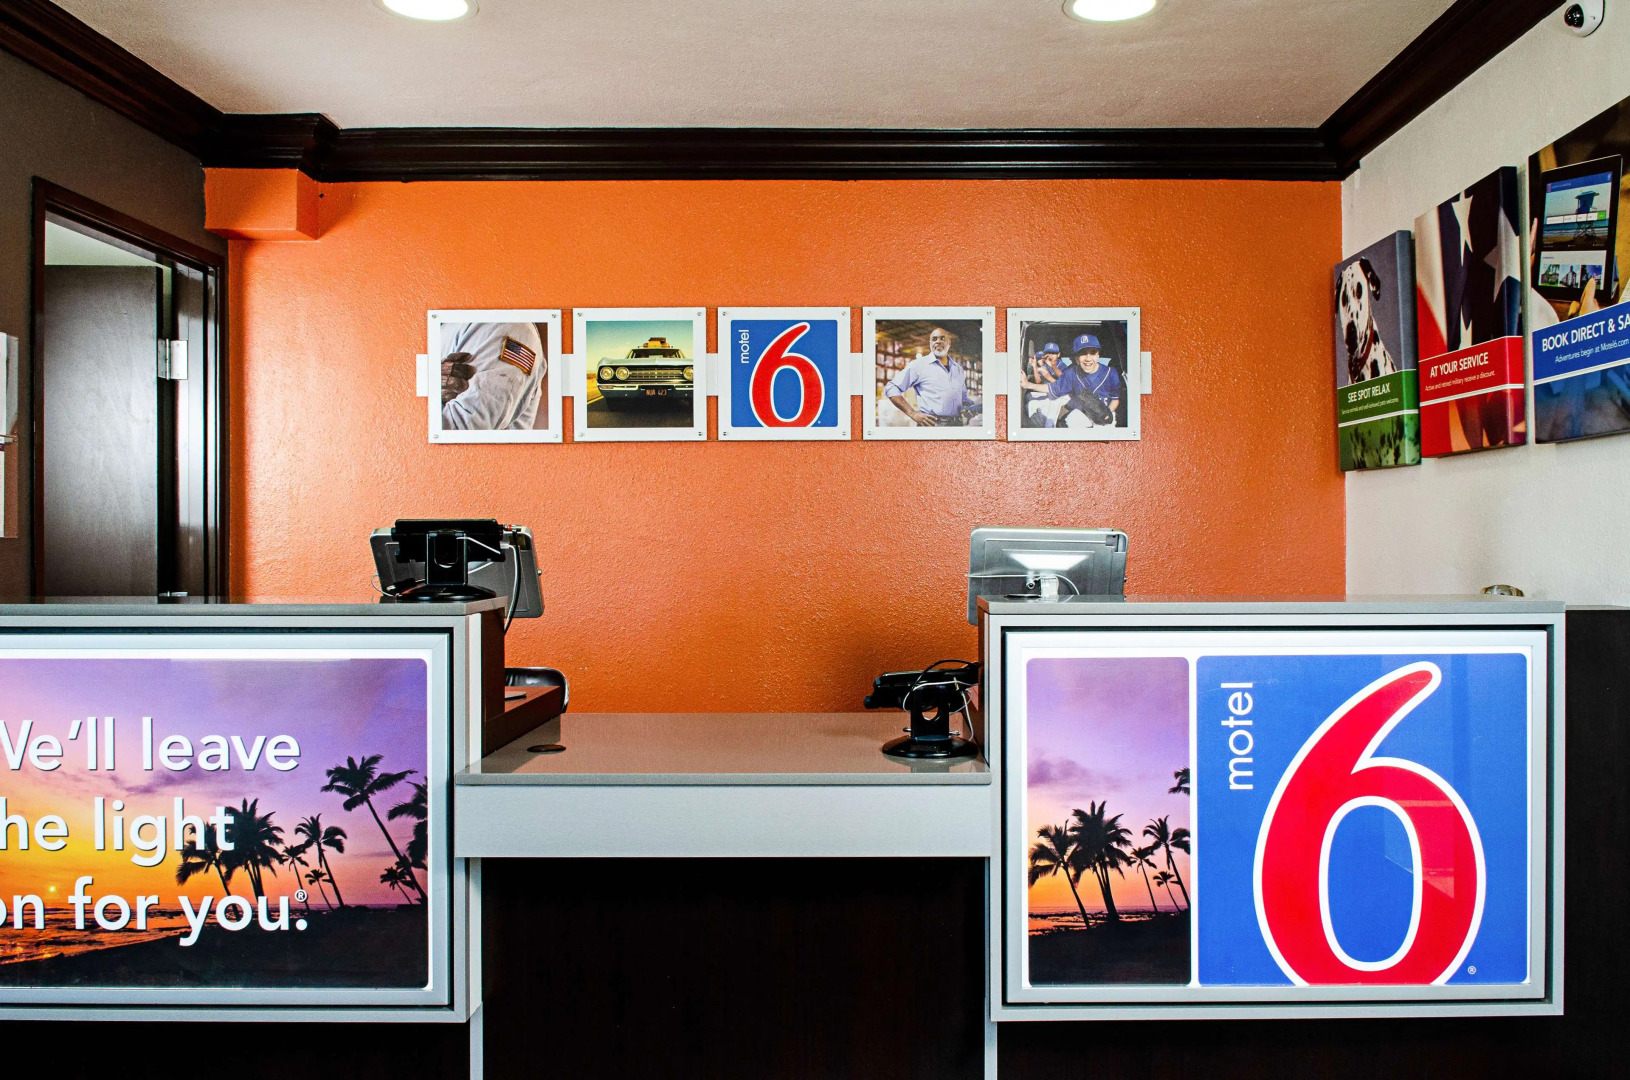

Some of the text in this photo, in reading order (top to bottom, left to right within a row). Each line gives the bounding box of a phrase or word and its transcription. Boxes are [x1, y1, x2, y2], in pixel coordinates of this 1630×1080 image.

[738, 329, 750, 364] motel
[1542, 331, 1569, 352] BOOK
[1571, 321, 1605, 344] DIRECT
[1608, 318, 1615, 333] &
[1554, 352, 1580, 363] Adventures
[1581, 347, 1594, 358] begin
[749, 321, 826, 427] 6
[1347, 382, 1391, 403] SEE SPOT RELAX
[1430, 352, 1489, 378] AT YOUR SERVICE
[141, 716, 302, 771] leave
[1221, 680, 1254, 792] motel
[93, 796, 236, 867] light
[1252, 660, 1487, 987] 6
[0, 893, 46, 930] n
[68, 876, 160, 931] for
